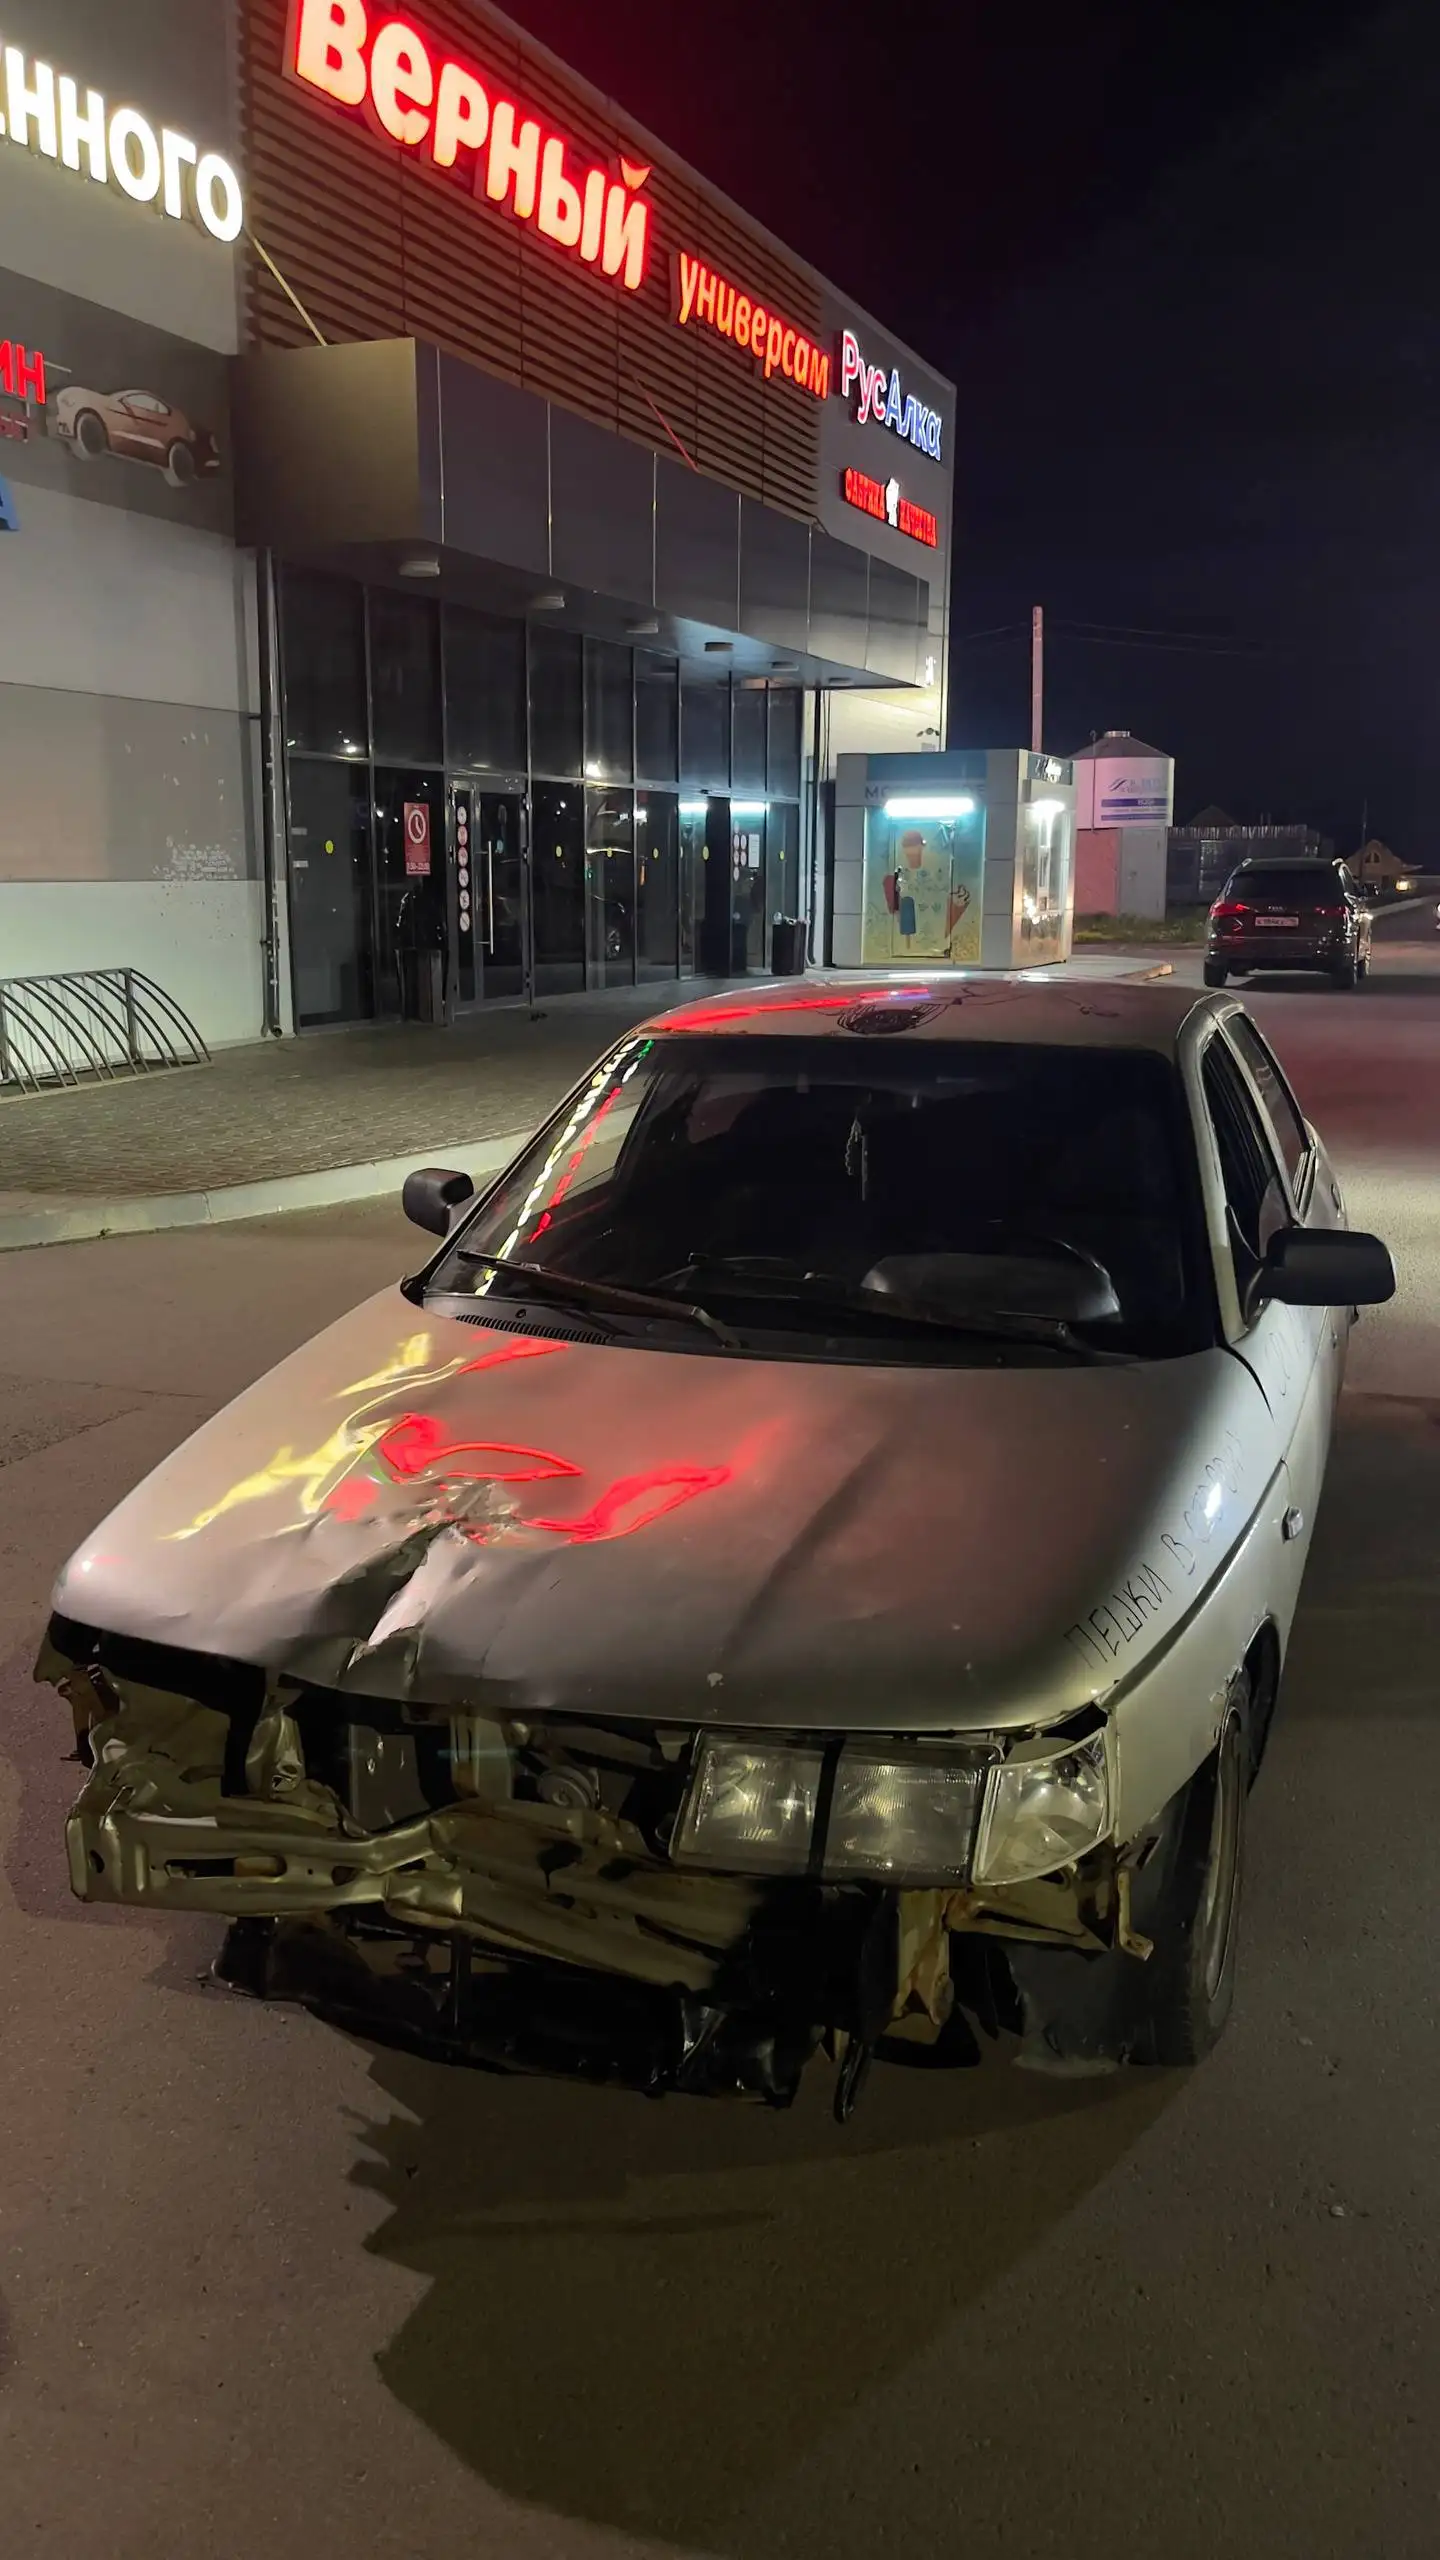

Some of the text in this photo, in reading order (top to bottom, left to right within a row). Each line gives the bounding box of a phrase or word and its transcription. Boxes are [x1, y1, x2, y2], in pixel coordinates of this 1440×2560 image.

[0, 46, 243, 242] ННОГО
[679, 252, 830, 400] универсам
[1064, 1562, 1173, 1669] ПЕШКИ
